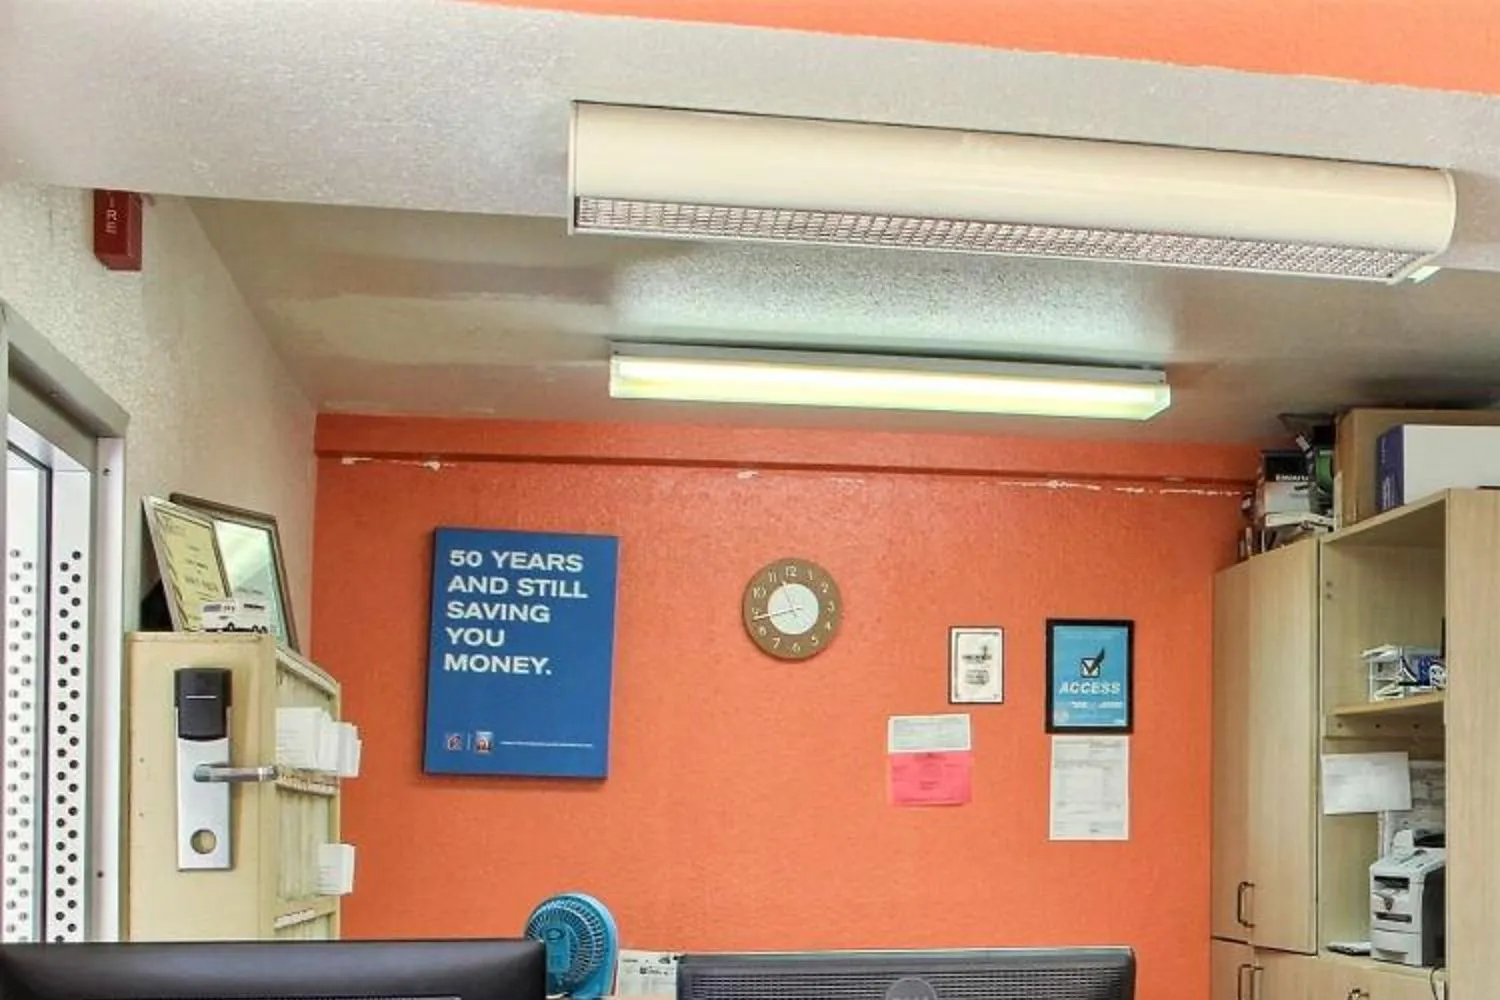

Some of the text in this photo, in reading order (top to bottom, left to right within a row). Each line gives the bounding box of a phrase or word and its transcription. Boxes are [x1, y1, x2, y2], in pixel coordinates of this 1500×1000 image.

[449, 549, 584, 573] 50 YEARS
[785, 566, 797, 578] 12
[447, 575, 588, 599] AND STILL
[447, 600, 551, 623] SAVING
[445, 627, 506, 647] YOU
[443, 653, 552, 676] MONEY.
[1058, 681, 1121, 695] ACCESS
